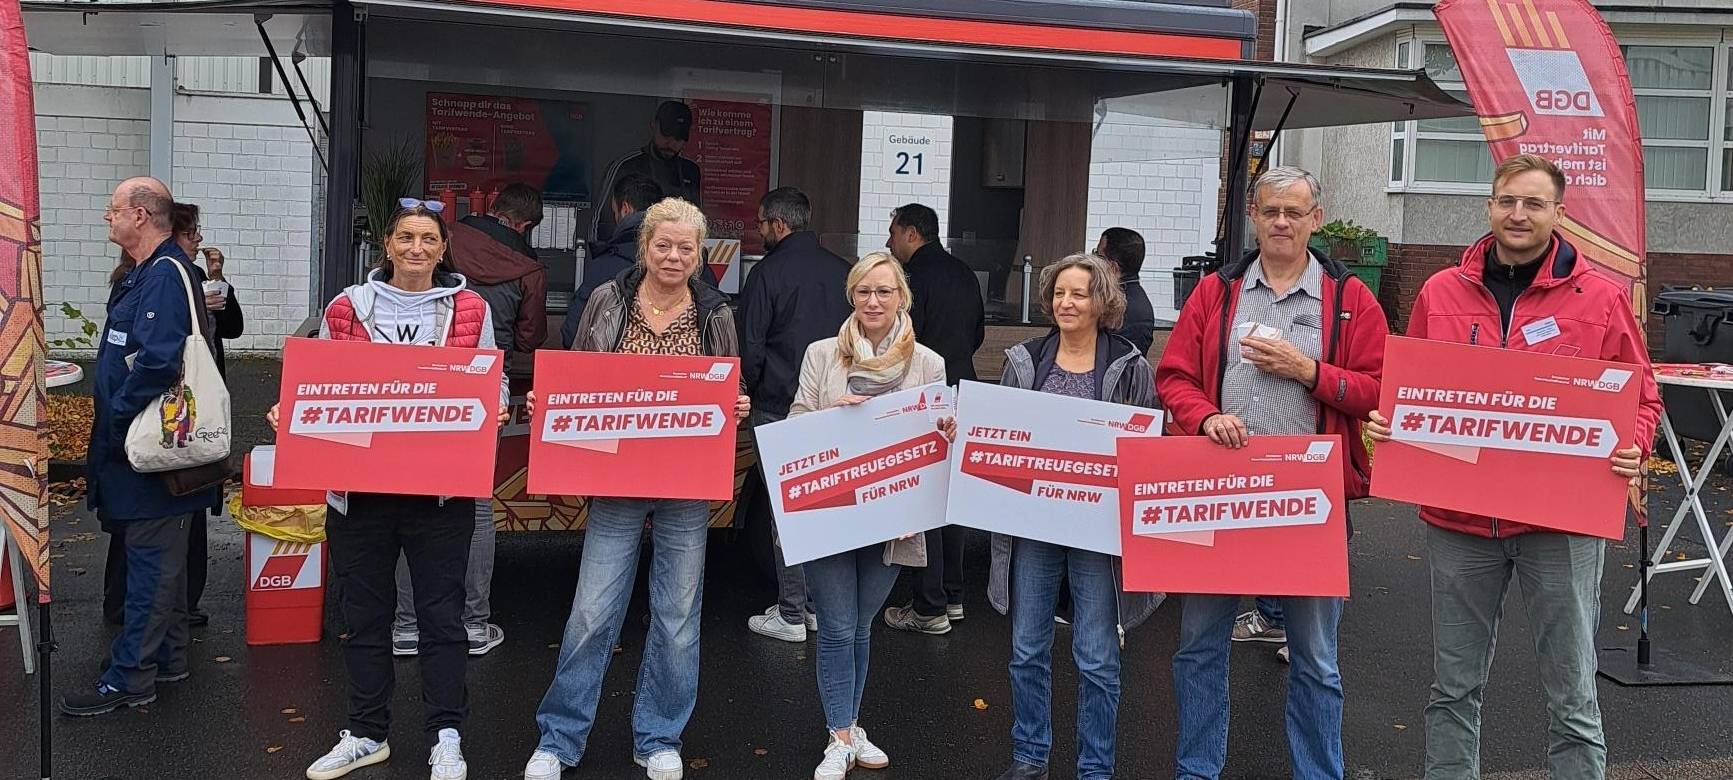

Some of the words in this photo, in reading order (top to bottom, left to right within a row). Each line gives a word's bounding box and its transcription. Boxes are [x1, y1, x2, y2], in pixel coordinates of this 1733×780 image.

[432, 98, 476, 110] Schnapp
[478, 100, 491, 109] dir
[493, 101, 512, 110] das
[699, 108, 716, 116] Wie
[717, 109, 752, 118] komme
[698, 125, 757, 138] Tarifvertrag?
[889, 134, 930, 144] Gebäude
[896, 151, 922, 175] 21
[297, 383, 381, 396] EINTRETEN
[382, 380, 410, 395] FÜR
[412, 382, 437, 394] DIE
[548, 392, 626, 405] EINTRETEN
[626, 389, 654, 403] FÜR
[656, 390, 679, 402] DIE
[1397, 386, 1488, 405] EINTRETEN
[1491, 391, 1525, 408] FÜR
[1528, 396, 1558, 411] DIE
[300, 405, 475, 425] #TARIFWENDE
[551, 411, 714, 433] #TARIFWENDE
[967, 426, 1007, 440] JETZT
[1009, 430, 1032, 442] EIN
[1400, 412, 1603, 447] #TARIFWENDE
[778, 454, 816, 476] JETZT
[819, 447, 840, 463] EIN
[788, 440, 938, 500] #TARIFTREUEGESETZ
[969, 449, 1118, 478] #TARIFTREUEGESET
[861, 486, 888, 504] FÜR
[889, 474, 921, 494] NRW
[1037, 483, 1064, 499] FÜR
[1067, 489, 1102, 504] NRW
[1134, 479, 1214, 496] EINTRETEN
[1217, 474, 1247, 490] FÜR
[1249, 474, 1274, 488] DIE
[1141, 496, 1318, 525] #TARIFWENDE
[260, 575, 292, 587] DGB
